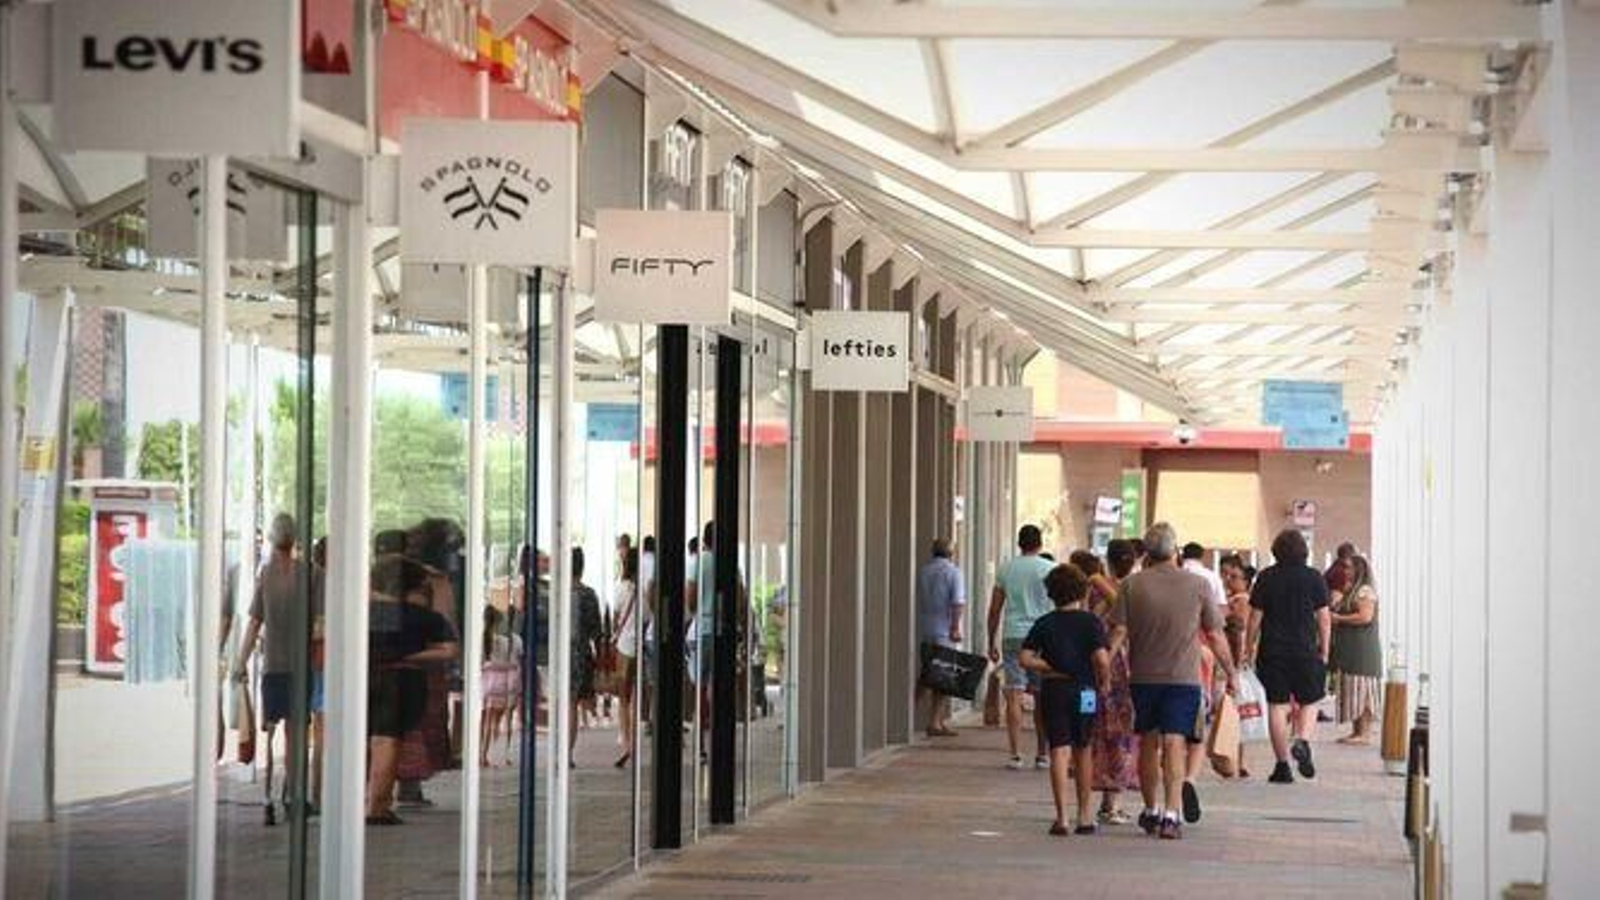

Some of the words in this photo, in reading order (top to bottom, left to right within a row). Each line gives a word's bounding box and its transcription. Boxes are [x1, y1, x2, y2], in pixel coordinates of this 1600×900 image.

[420, 156, 552, 193] SPAGNOLO
[611, 258, 714, 276] FIFTY
[823, 339, 897, 358] lefties
